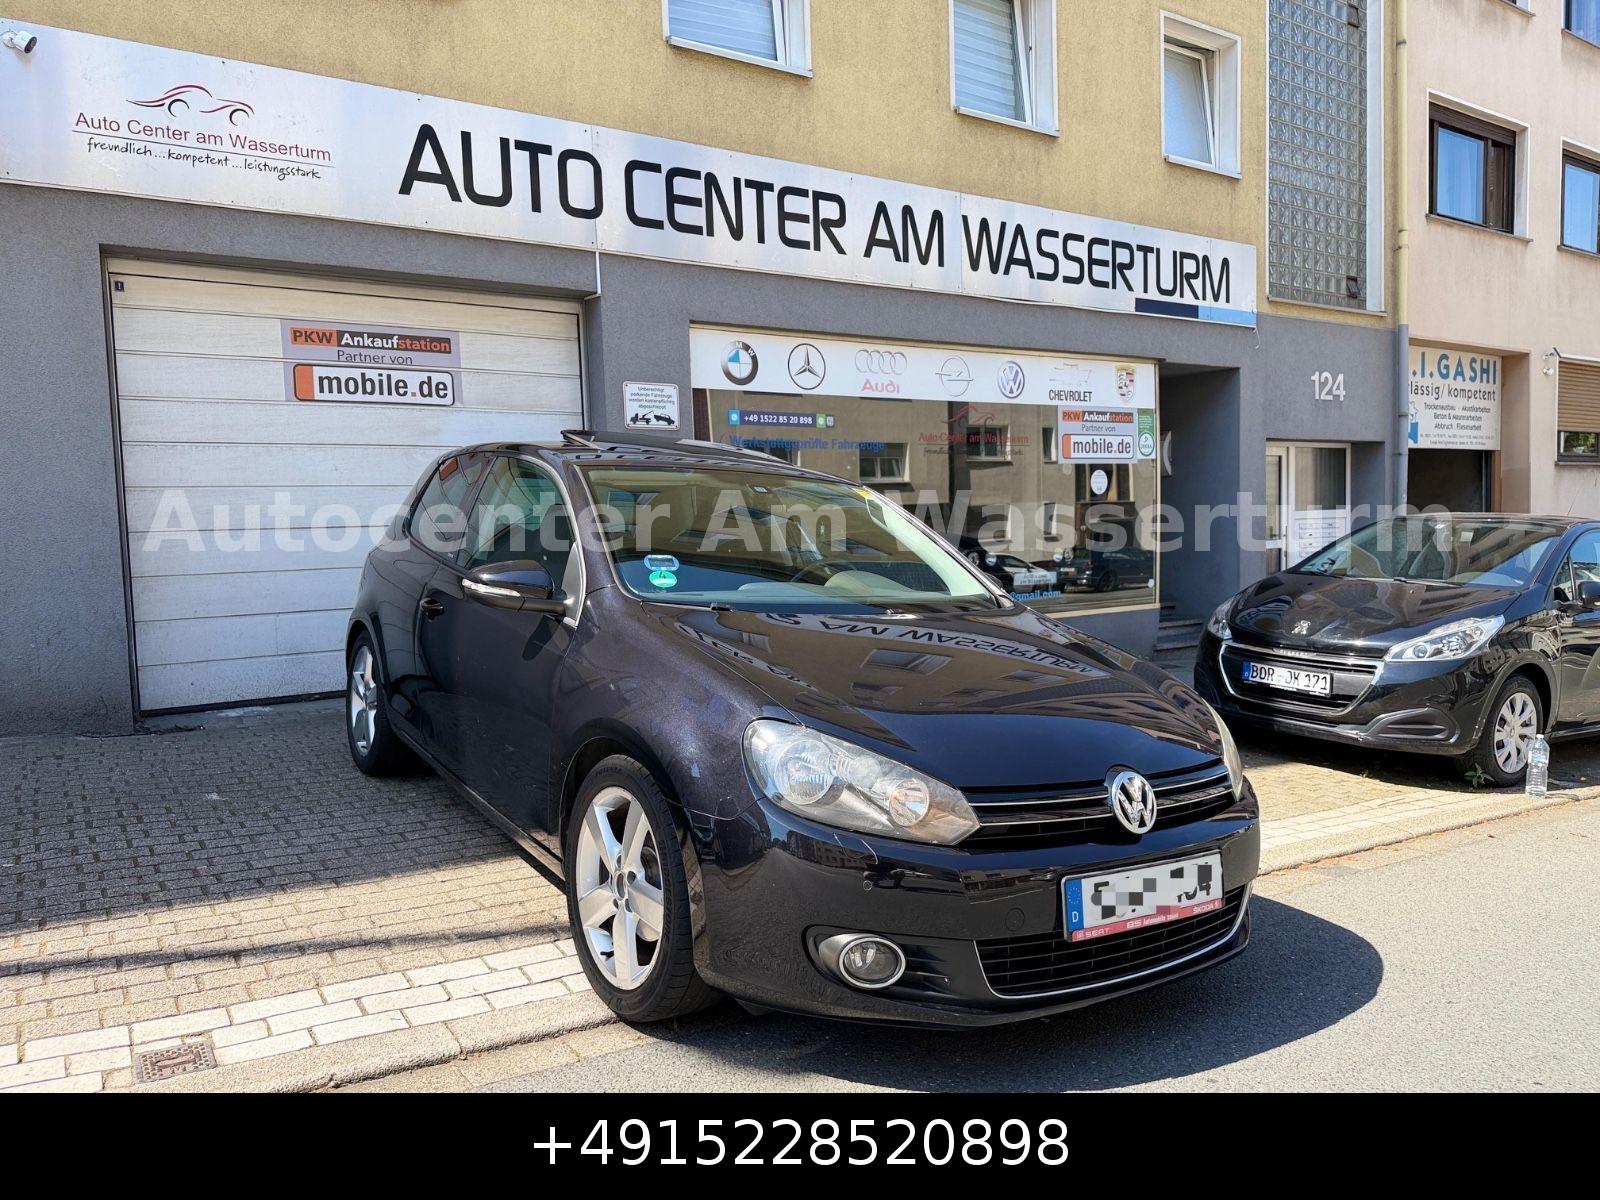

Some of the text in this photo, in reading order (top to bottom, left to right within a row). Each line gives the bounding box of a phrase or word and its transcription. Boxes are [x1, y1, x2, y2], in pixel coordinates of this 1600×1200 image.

[75, 112, 331, 162] Auto Center am Wasserturm
[398, 123, 1230, 304] AUTO CENTER AM WASSERTURM
[292, 329, 450, 352] PKW Ankaufstation
[337, 350, 413, 365] Partner von
[318, 372, 449, 399] mobile.de
[861, 379, 900, 394] Audi
[1310, 371, 1346, 402] 124
[1447, 382, 1496, 402] kompetent
[1048, 389, 1093, 402] CHEVROLET
[743, 414, 813, 425] +49 1522 85 20 898
[1062, 411, 1081, 421] PKW
[1083, 412, 1133, 423] Ankaufstation
[1081, 424, 1104, 432] Partner
[1072, 438, 1131, 454] mobile.de
[1251, 664, 1275, 681] BOR
[1304, 673, 1328, 690] 171
[1072, 911, 1079, 922] D
